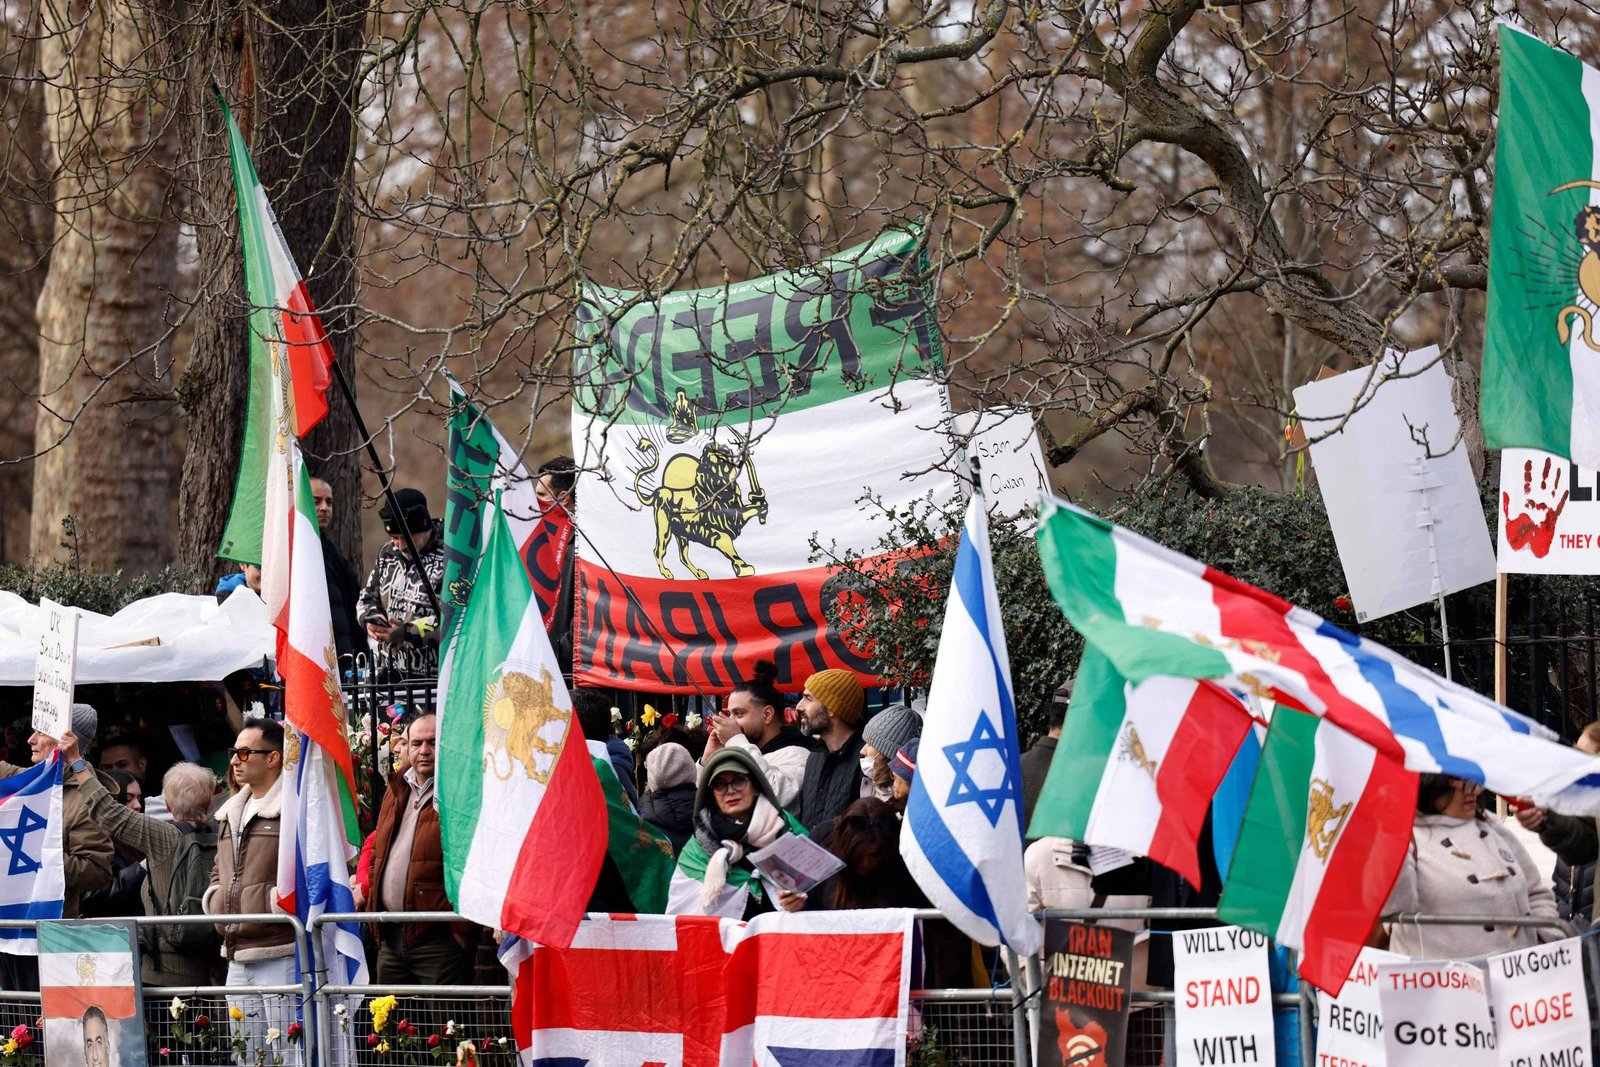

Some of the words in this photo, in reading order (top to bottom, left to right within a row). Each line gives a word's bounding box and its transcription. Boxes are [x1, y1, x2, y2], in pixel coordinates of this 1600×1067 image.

[1560, 534, 1592, 549] THEY
[1069, 925, 1112, 958] IRAN
[1184, 932, 1224, 954] WILL
[1228, 928, 1264, 950] YOU
[1053, 952, 1124, 986] INTERNET
[1502, 955, 1526, 978] UK
[1527, 948, 1571, 972] Govt:
[1049, 977, 1125, 1012] BLACKOUT
[1186, 976, 1260, 1008] STAND
[1330, 1004, 1383, 1039] REGIM
[1510, 993, 1573, 1029] CLOSE
[1193, 1035, 1258, 1066] WITH
[1395, 1021, 1447, 1046] Got
[1455, 1022, 1494, 1050] Sho
